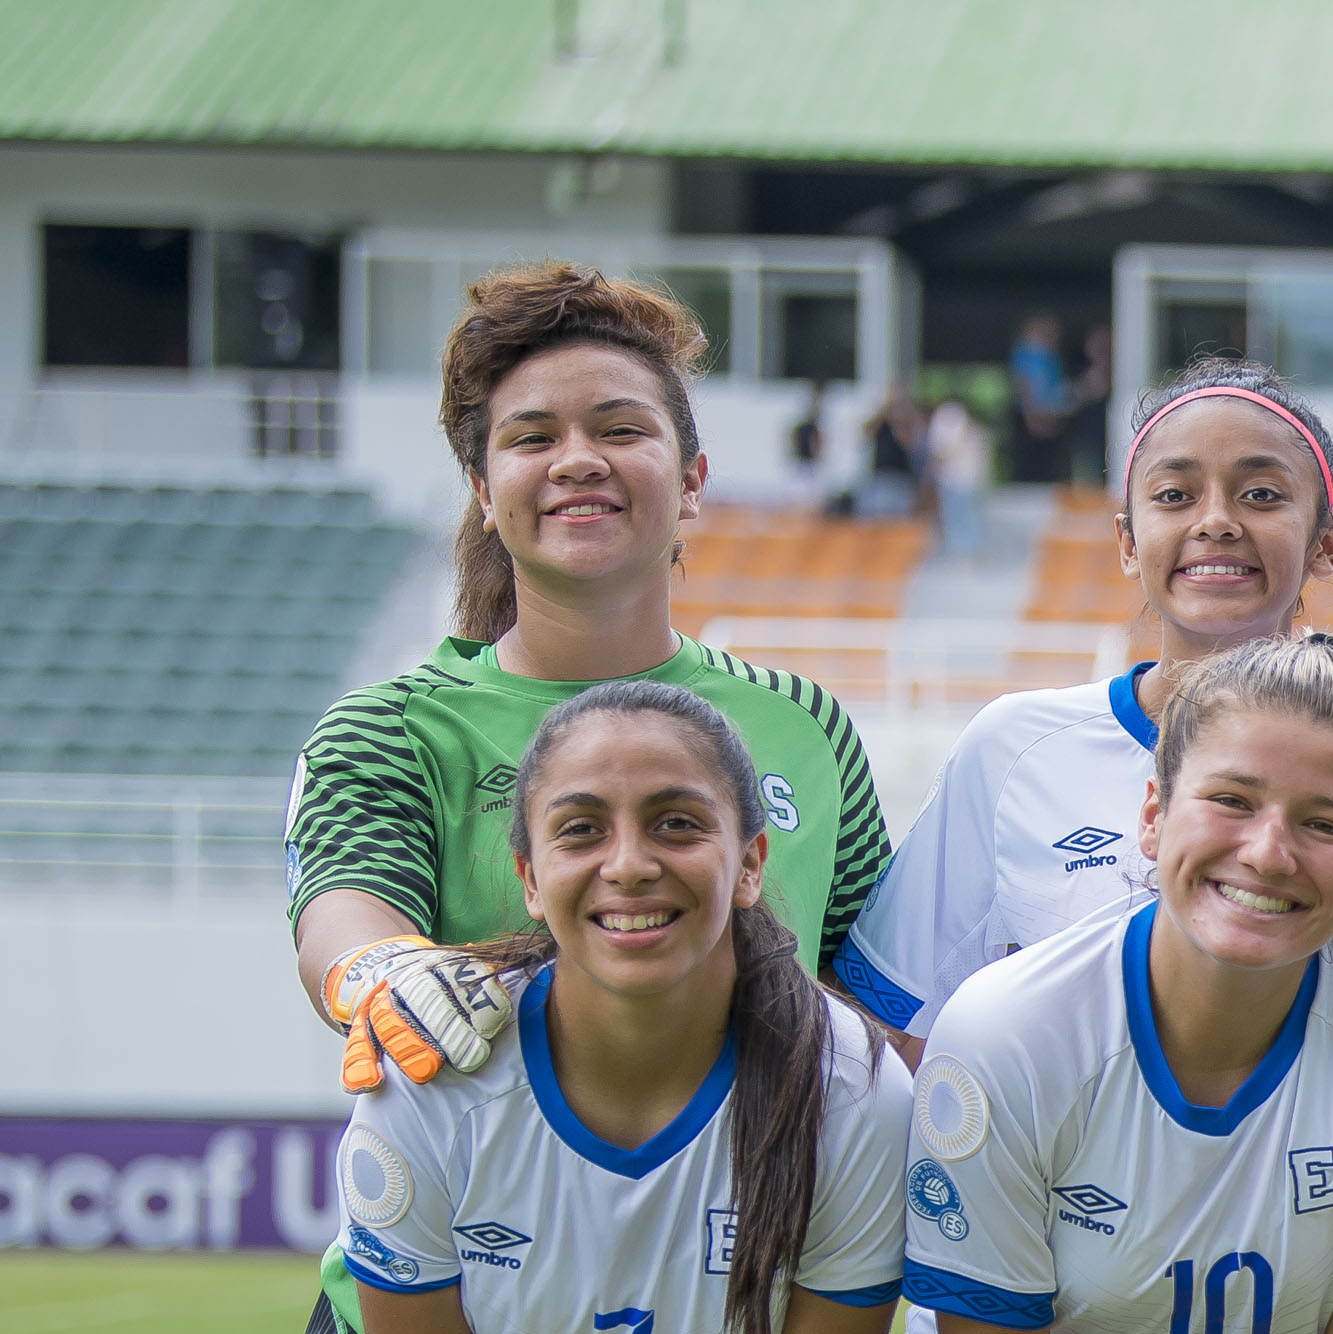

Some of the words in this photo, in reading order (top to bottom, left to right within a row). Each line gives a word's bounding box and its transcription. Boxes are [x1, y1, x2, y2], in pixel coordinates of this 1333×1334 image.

[481, 796, 512, 813] umb
[760, 773, 800, 832] S
[1065, 854, 1117, 873] umbro
[945, 1216, 962, 1234] ES
[1058, 1209, 1115, 1236] umbro
[705, 1208, 738, 1275] E
[461, 1249, 521, 1270] umbro
